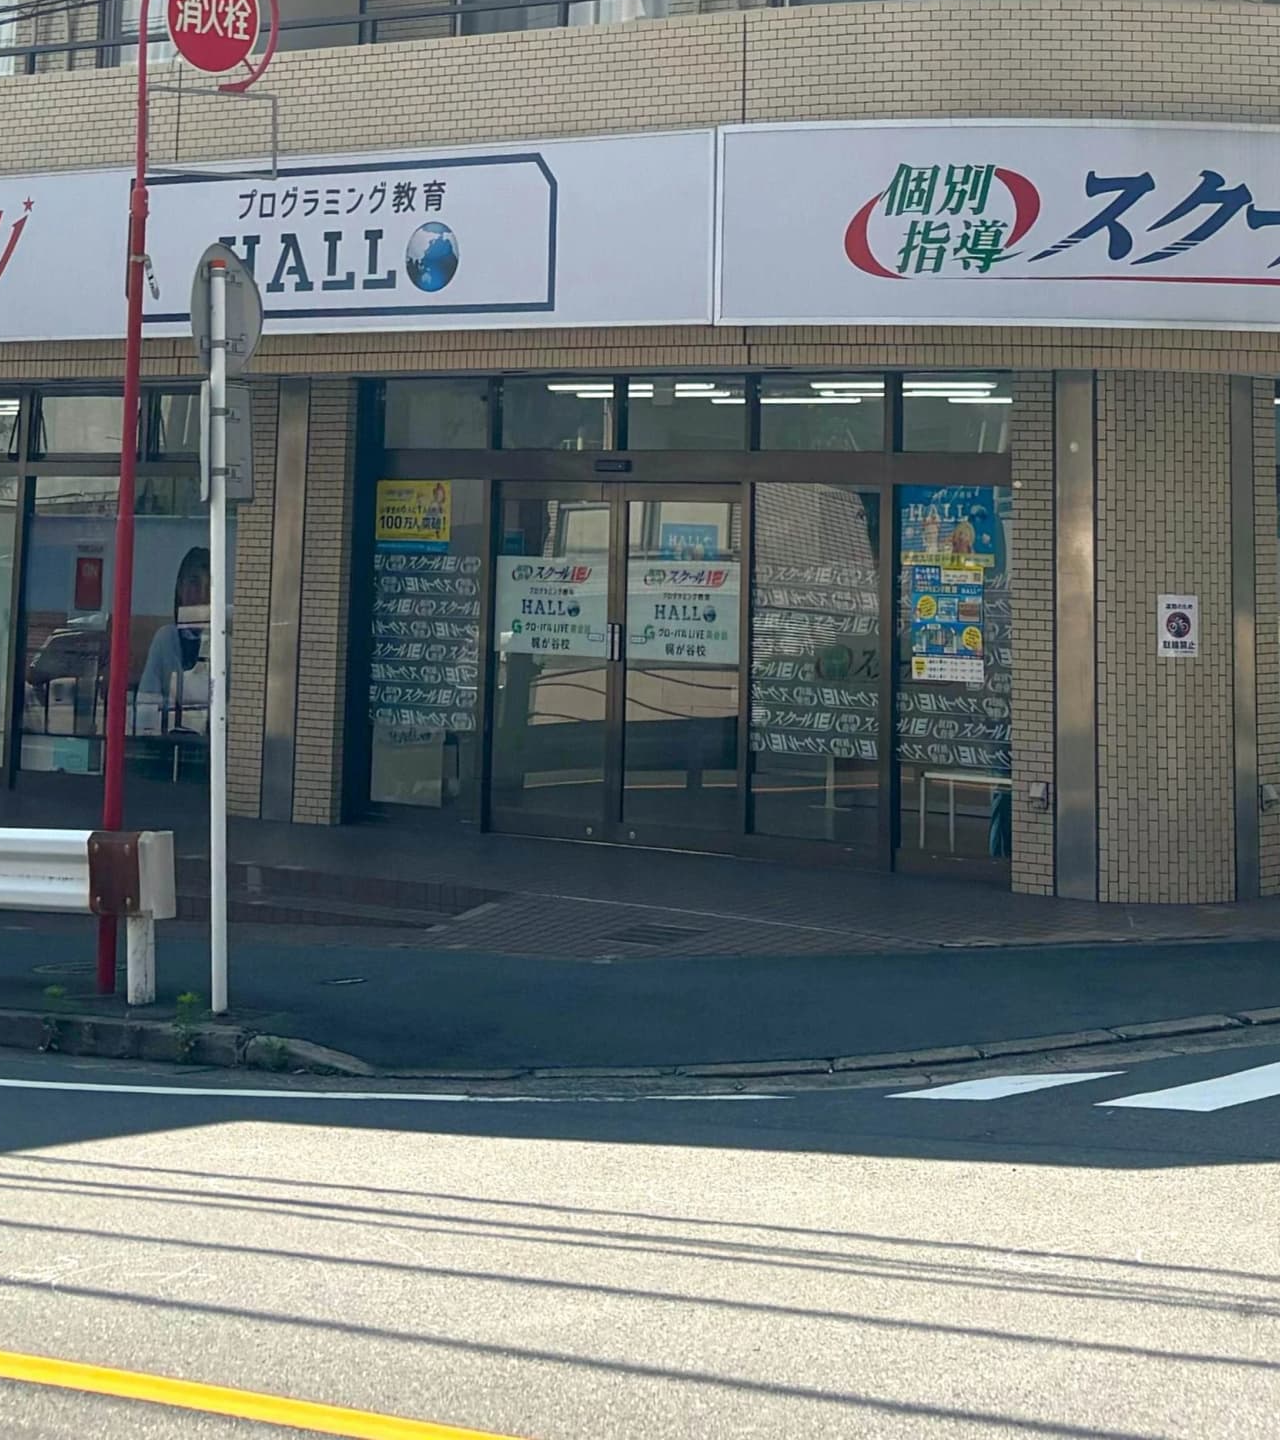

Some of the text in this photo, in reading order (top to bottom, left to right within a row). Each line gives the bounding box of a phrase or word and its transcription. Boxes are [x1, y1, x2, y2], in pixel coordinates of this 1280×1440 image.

[238, 179, 447, 220] プログラミング教育
[882, 163, 996, 217] 個別
[895, 217, 1014, 275] 指導
